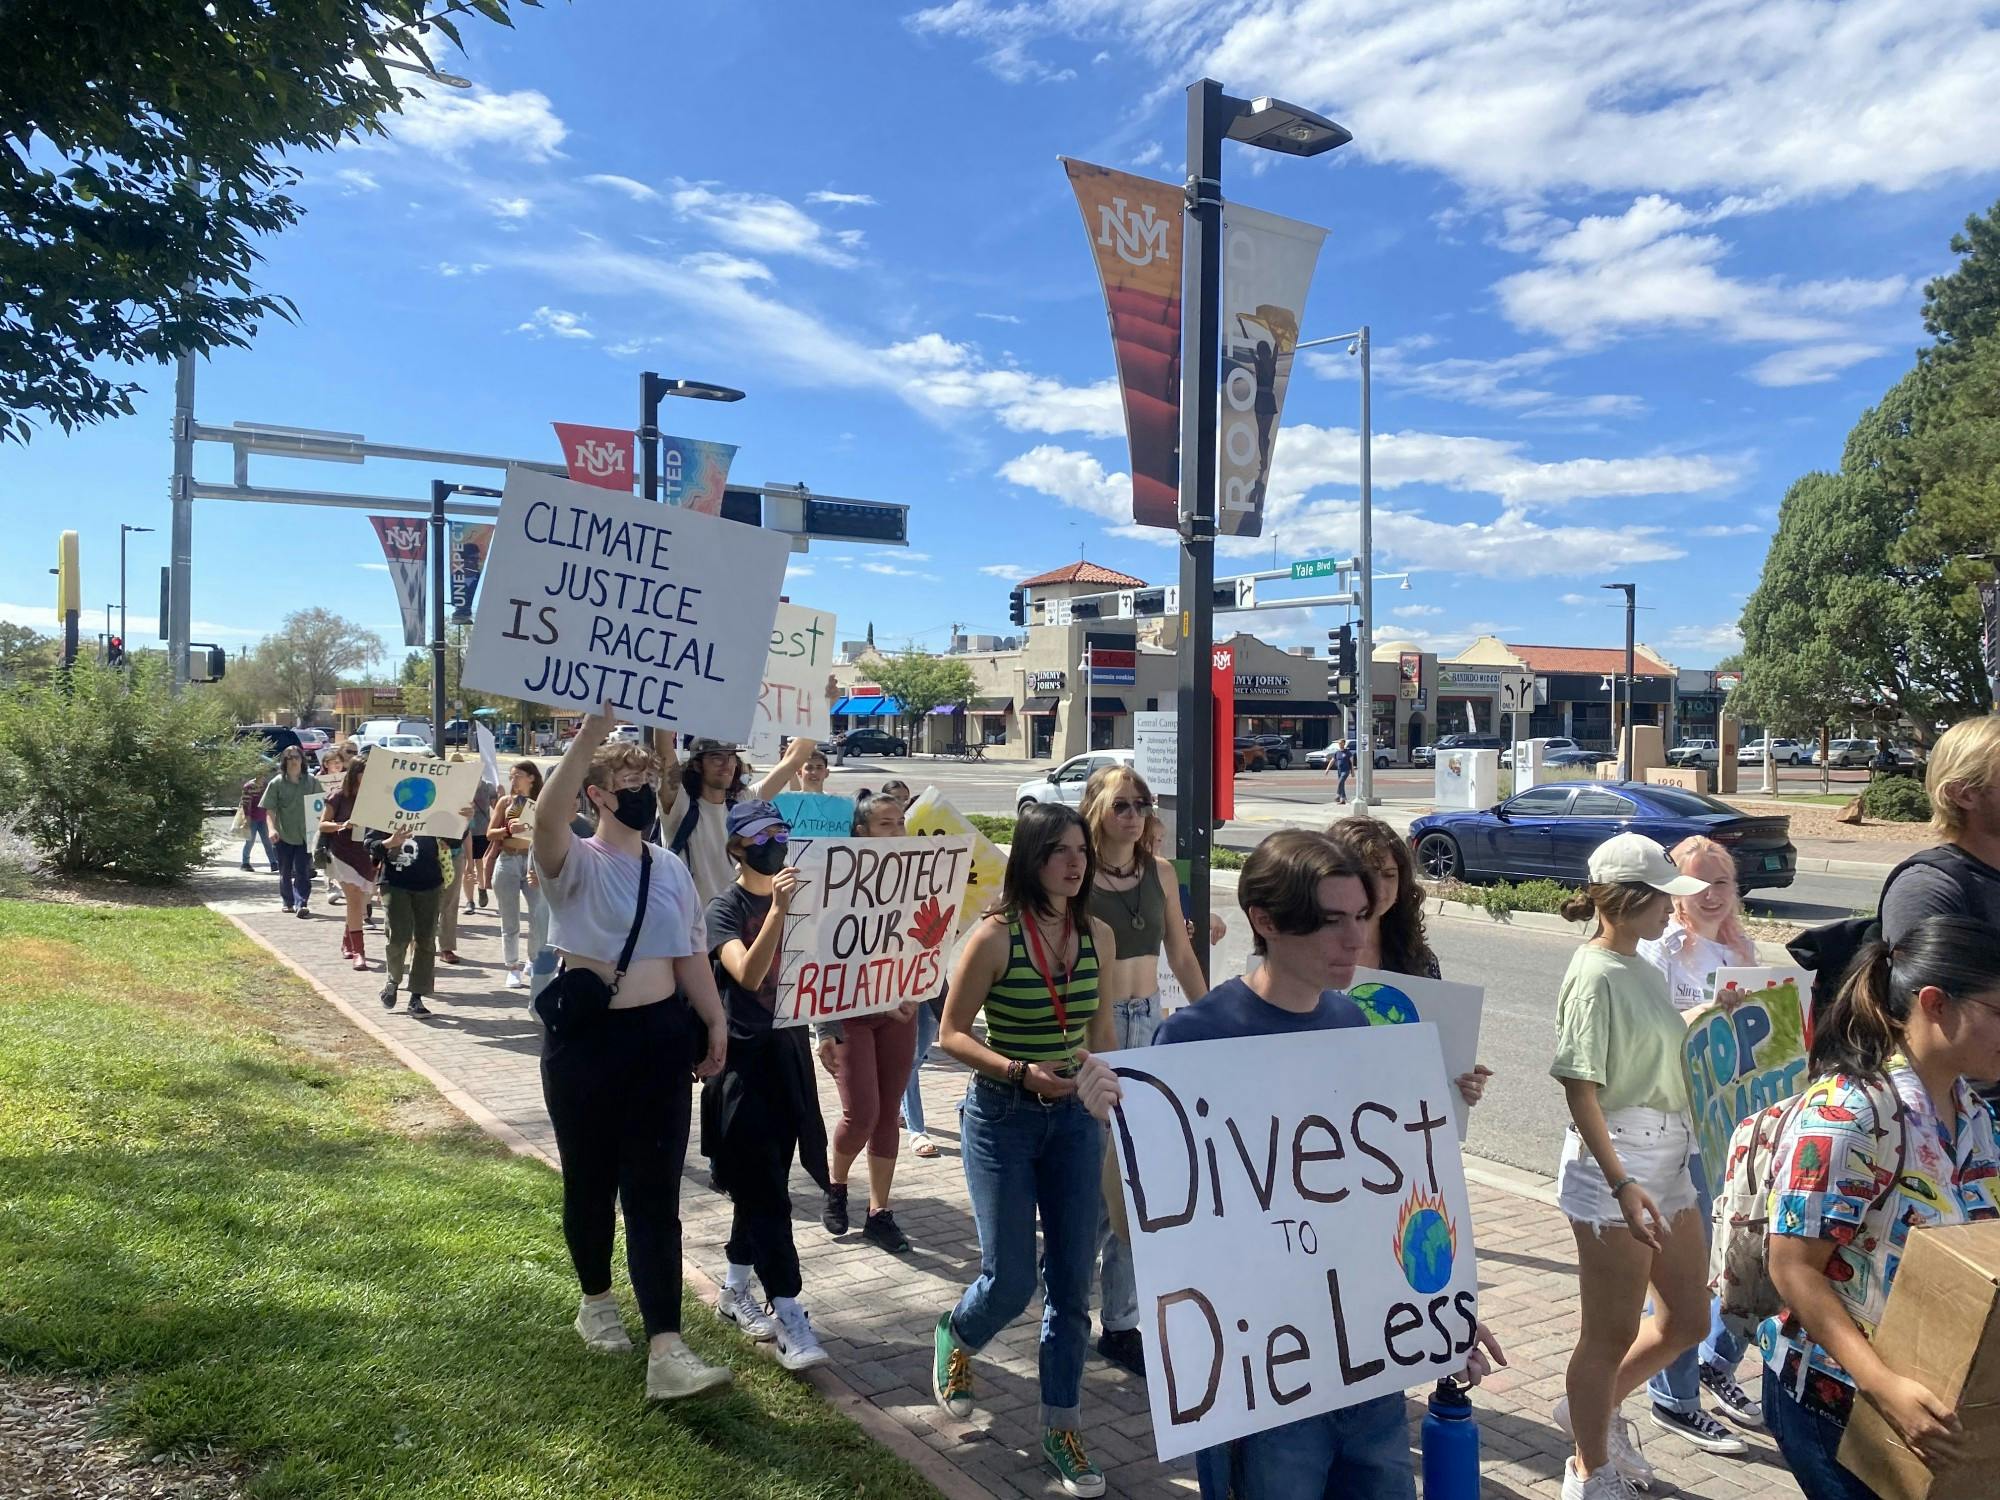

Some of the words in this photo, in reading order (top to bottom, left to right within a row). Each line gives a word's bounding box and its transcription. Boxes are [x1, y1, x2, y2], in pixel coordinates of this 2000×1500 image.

[524, 501, 673, 571] CLIMATE
[545, 561, 702, 625] JUSTICE
[1295, 563, 1314, 577] Yale
[1316, 560, 1331, 571] Blvd
[502, 598, 560, 645] IS
[589, 615, 725, 682] RACIAL
[524, 656, 684, 721] JUSTICE
[1037, 671, 1061, 681] JIMMY
[392, 758, 453, 776] PROTECT
[387, 820, 427, 832] PLANET
[395, 810, 421, 820] OUR
[822, 845, 968, 909] PROTECT
[832, 909, 904, 960] OUR
[792, 949, 942, 1020] RELATIVES
[1111, 1066, 1448, 1233] Divest
[1271, 1218, 1319, 1255] TO
[1156, 1286, 1312, 1426] Die
[1326, 1268, 1478, 1387] Less
